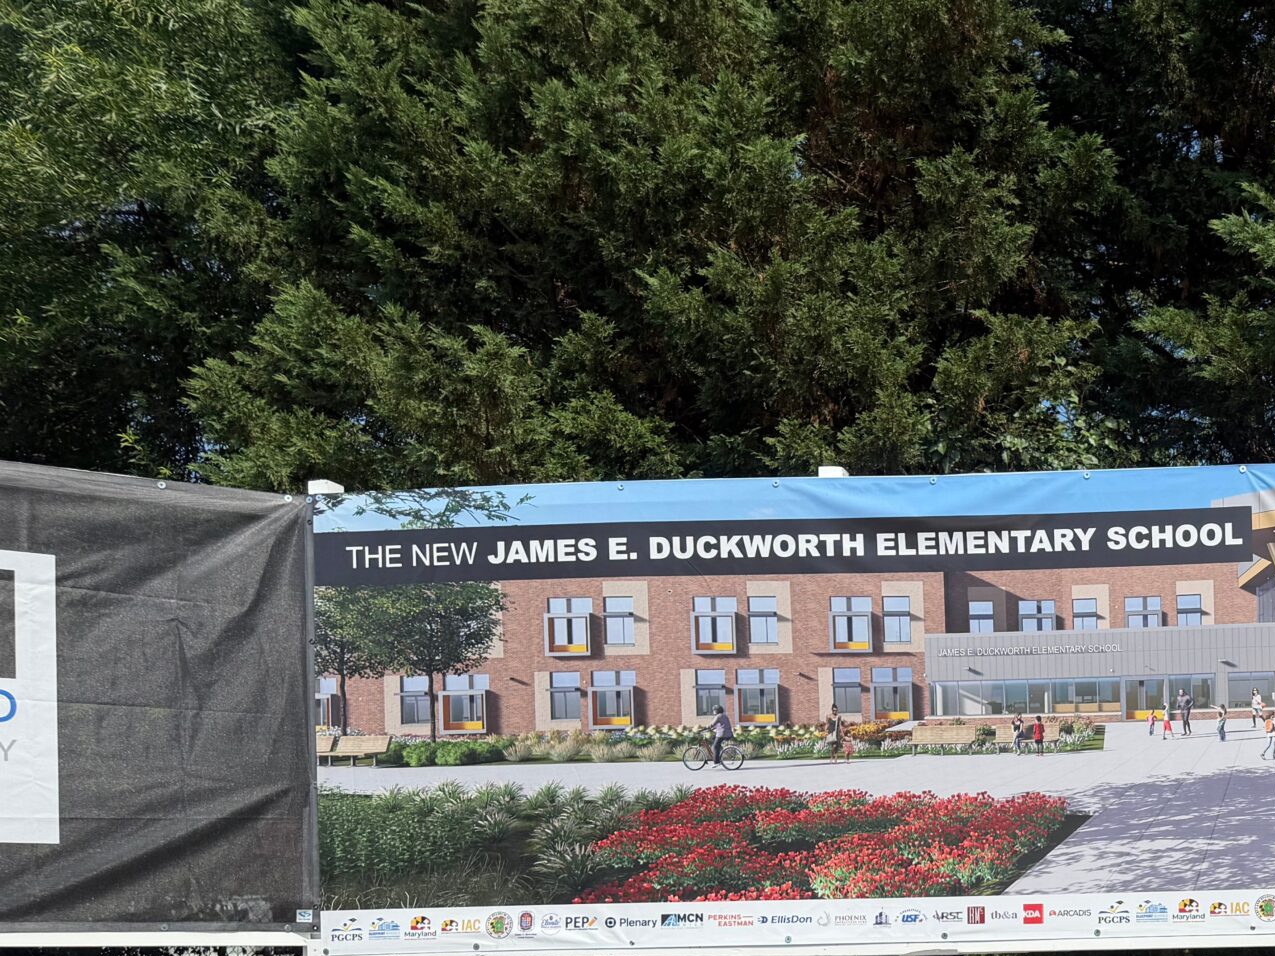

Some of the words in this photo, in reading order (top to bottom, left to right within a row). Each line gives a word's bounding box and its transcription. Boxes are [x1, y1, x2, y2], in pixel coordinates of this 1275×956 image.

[346, 544, 402, 569] THE
[412, 541, 478, 567] NEW
[487, 537, 598, 564] JAMES
[608, 536, 637, 561] E.
[649, 533, 865, 560] DUCKWORTH
[876, 528, 1097, 556] ELEMENTARY
[1106, 522, 1244, 551] SCHOOL
[938, 648, 965, 657] JAMES
[977, 646, 1031, 656] DUCKWORTH
[1032, 644, 1087, 655] ELEMENTARY
[1088, 643, 1123, 653] SCHOOL
[1230, 902, 1250, 914] IAC
[677, 913, 704, 922] MCN
[1057, 909, 1091, 917] ARCADIS
[1172, 912, 1206, 921] Maryland
[565, 916, 589, 929] PEP
[620, 917, 657, 928] Plenary
[771, 915, 812, 924] EllisDon
[902, 914, 919, 923] USF
[1098, 915, 1130, 924] PGCPS
[461, 919, 481, 931] IAC
[331, 933, 363, 942] PGCPS
[404, 930, 437, 939] Maryland
